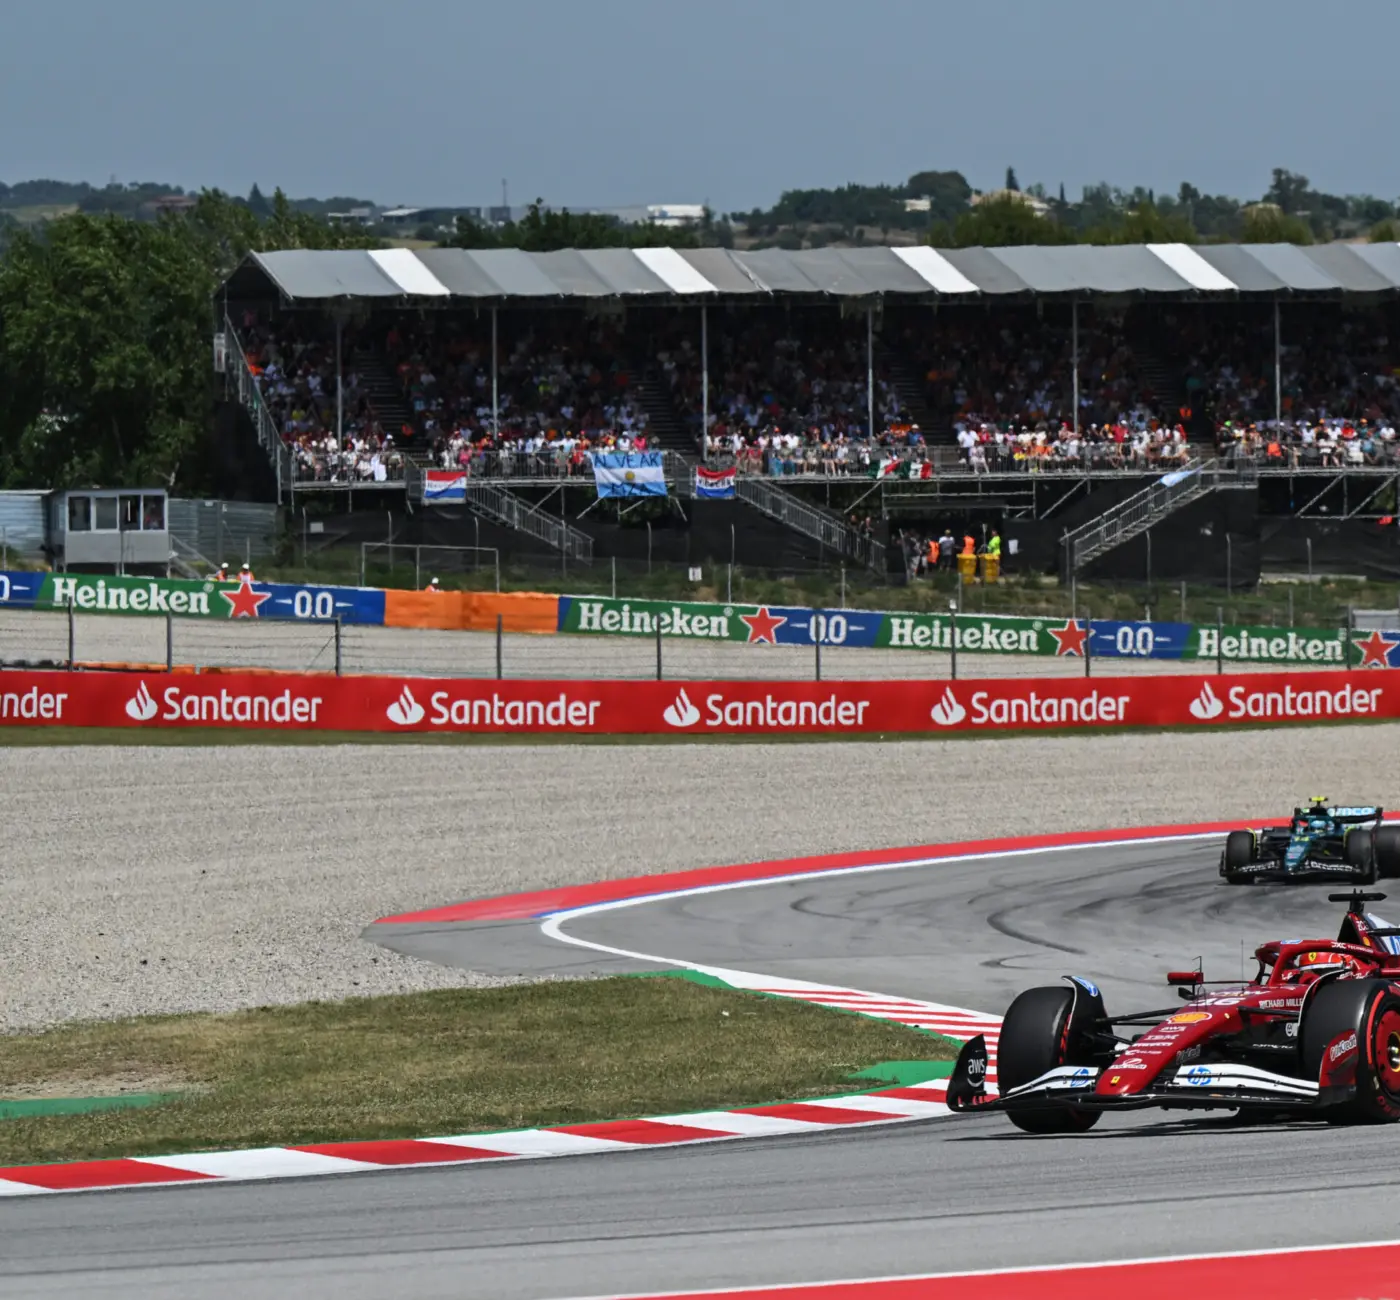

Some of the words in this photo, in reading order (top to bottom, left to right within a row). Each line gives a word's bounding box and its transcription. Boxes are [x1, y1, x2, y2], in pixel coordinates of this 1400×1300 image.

[53, 577, 210, 614] Heineken
[579, 602, 730, 637] Heineken
[889, 618, 1039, 651] Heineken
[1198, 629, 1344, 661] Heineken
[164, 687, 322, 722] Santander
[431, 691, 601, 726] Santander
[706, 694, 870, 726] Santander
[971, 691, 1130, 724] Santander
[1228, 684, 1383, 717] Santander
[968, 1058, 986, 1075] aws
